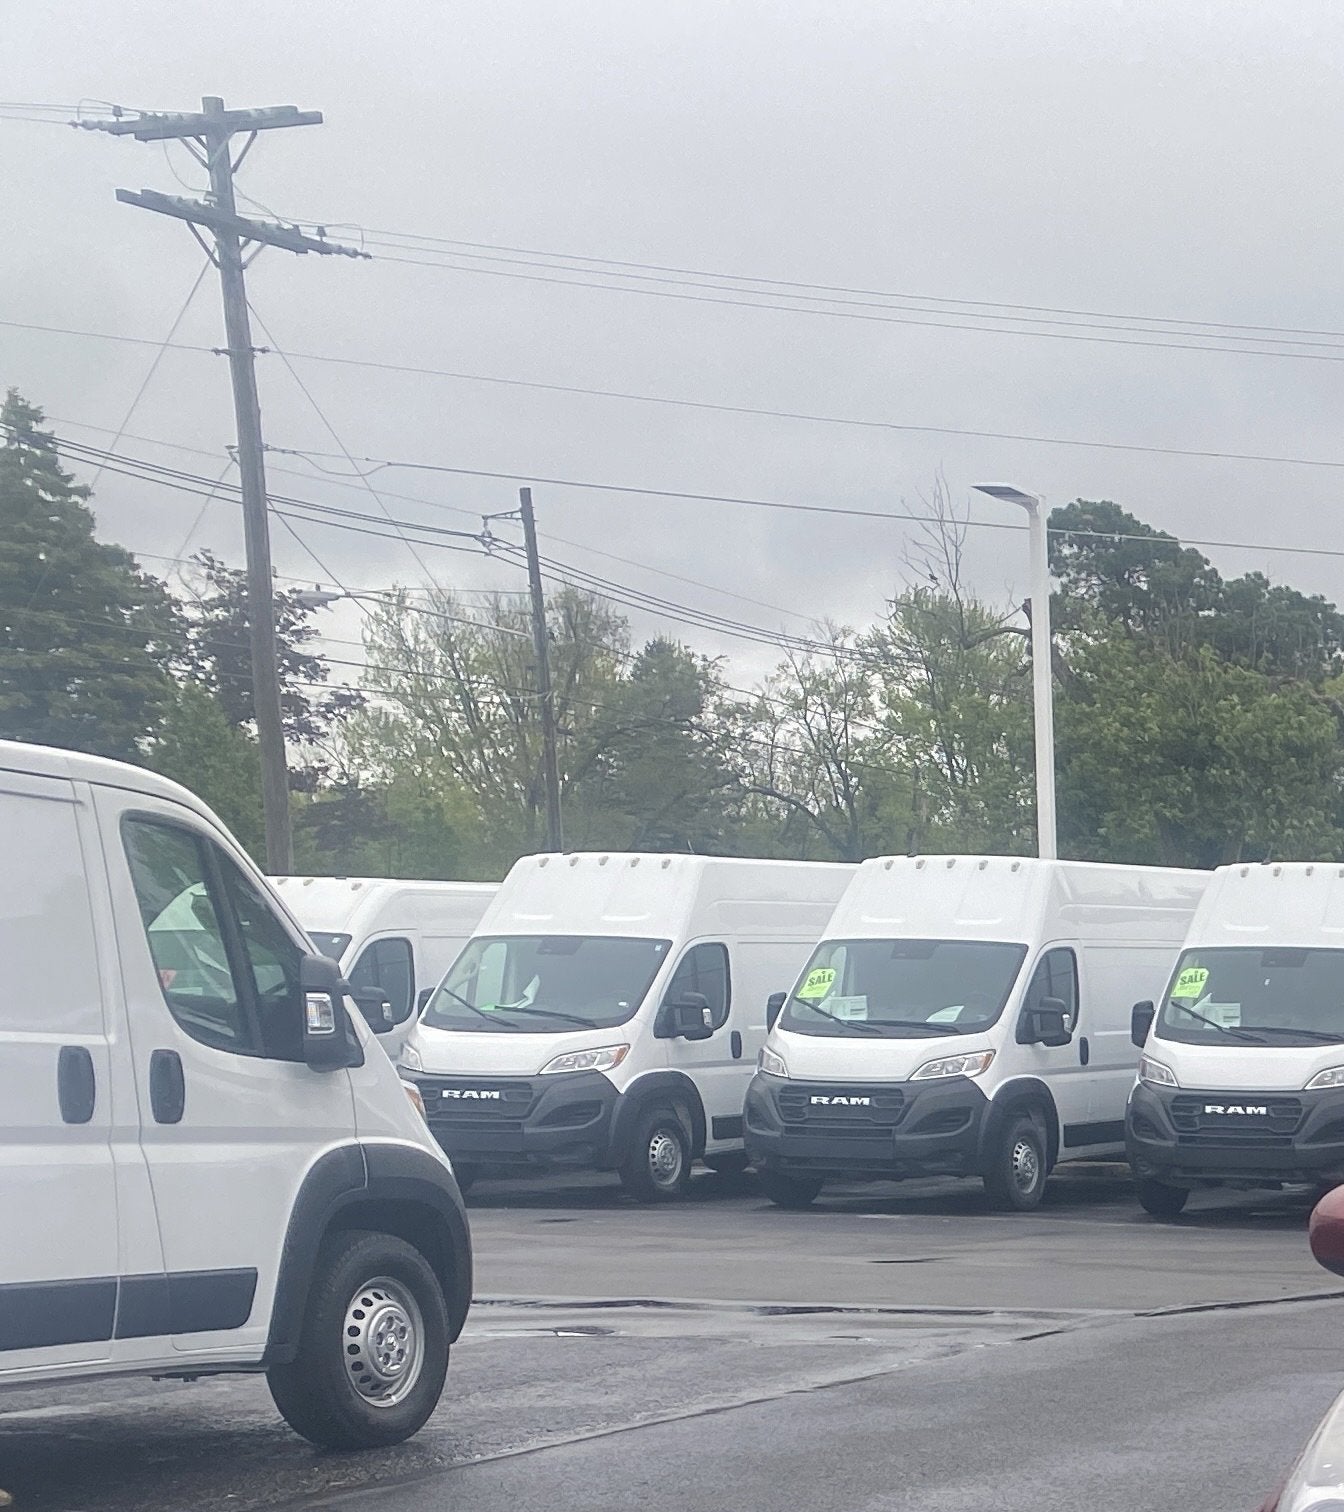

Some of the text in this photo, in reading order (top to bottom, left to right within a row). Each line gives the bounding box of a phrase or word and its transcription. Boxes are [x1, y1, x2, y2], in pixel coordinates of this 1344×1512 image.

[807, 973, 833, 987] SALE
[1180, 971, 1206, 986] SALE
[441, 1089, 500, 1099] RAM
[810, 1096, 871, 1106] RAM
[1204, 1105, 1267, 1115] RAM
